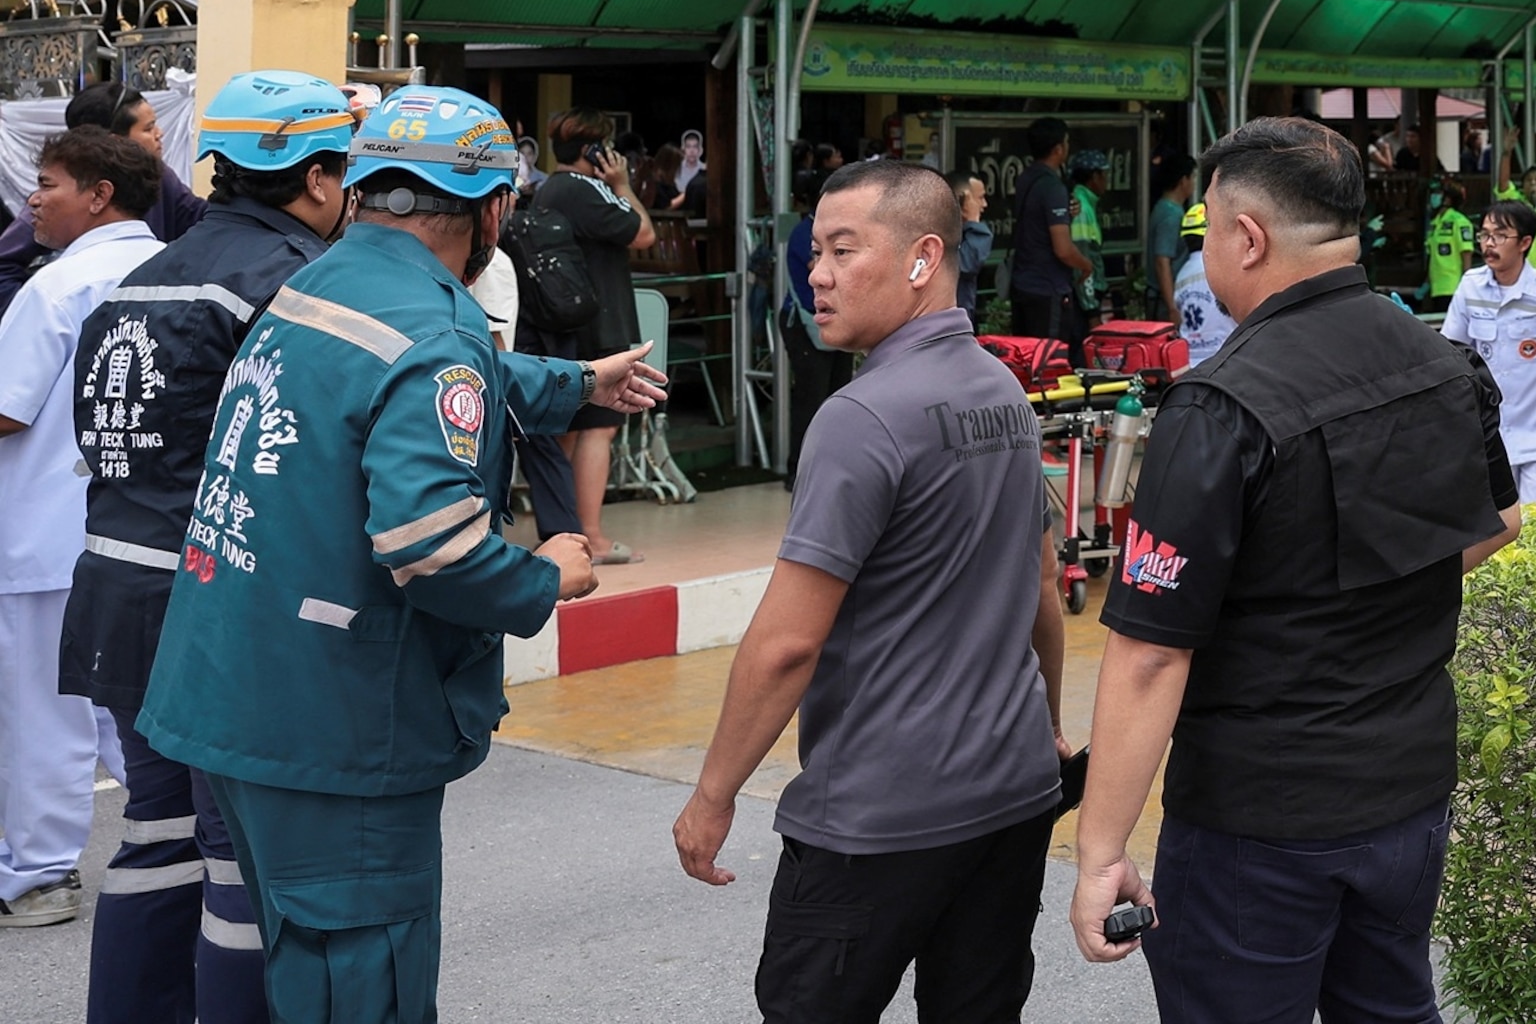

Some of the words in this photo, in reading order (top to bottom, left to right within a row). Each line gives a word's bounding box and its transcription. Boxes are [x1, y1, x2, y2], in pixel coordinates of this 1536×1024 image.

[388, 119, 428, 141] 65
[362, 143, 402, 154] PELICAN
[444, 369, 482, 391] RESCUE
[924, 401, 1038, 452] Transpor
[100, 432, 125, 447] TECK
[130, 432, 164, 448] TUNG
[99, 460, 130, 478] 1418
[194, 470, 255, 543] 德堂
[191, 519, 220, 550] TECK
[222, 536, 256, 573] TUNG
[1141, 573, 1180, 590] SIREN
